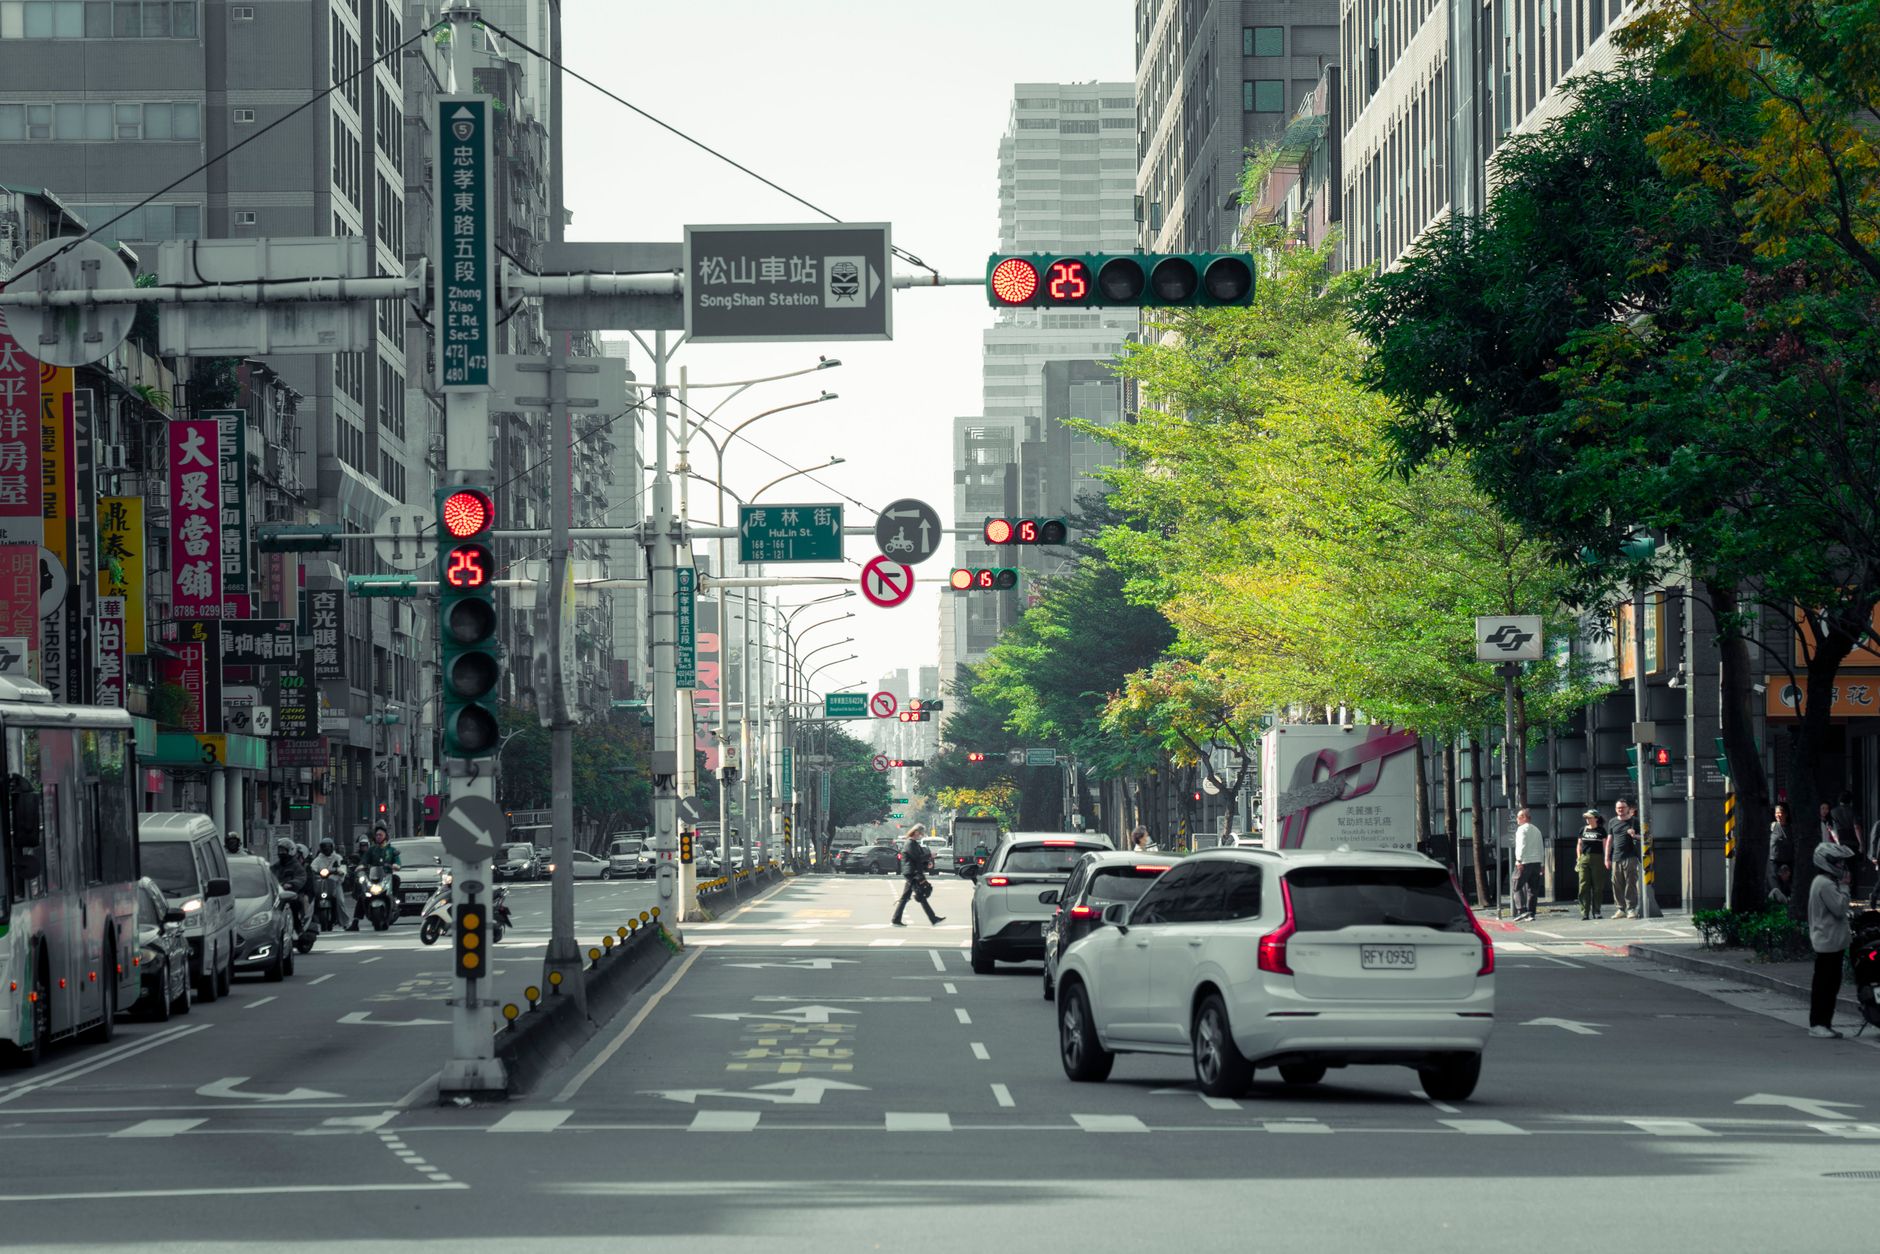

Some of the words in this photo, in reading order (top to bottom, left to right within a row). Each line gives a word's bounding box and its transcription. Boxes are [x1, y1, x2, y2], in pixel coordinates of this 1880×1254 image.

[453, 146, 475, 282] 忠孝東路五段
[699, 256, 818, 285] 松山車站
[1050, 264, 1085, 298] 25
[448, 286, 481, 300] Zhong
[700, 293, 765, 310] SongShan
[769, 292, 819, 306] Station
[449, 301, 473, 312] Xiao
[449, 314, 459, 326] E.
[461, 313, 479, 326] Rd.
[449, 328, 479, 340] Sec.5
[446, 344, 464, 358] 472
[469, 355, 487, 369] 473
[446, 367, 464, 381] 480
[749, 508, 831, 528] 虎林街
[769, 529, 797, 538] HuLin
[800, 528, 813, 537] St.
[1021, 522, 1034, 541] 15
[448, 551, 482, 586] 25
[980, 571, 992, 587] 15
[174, 605, 220, 617] 8786-0299
[312, 592, 338, 665] 杏光眼鏡
[202, 743, 217, 765] 3
